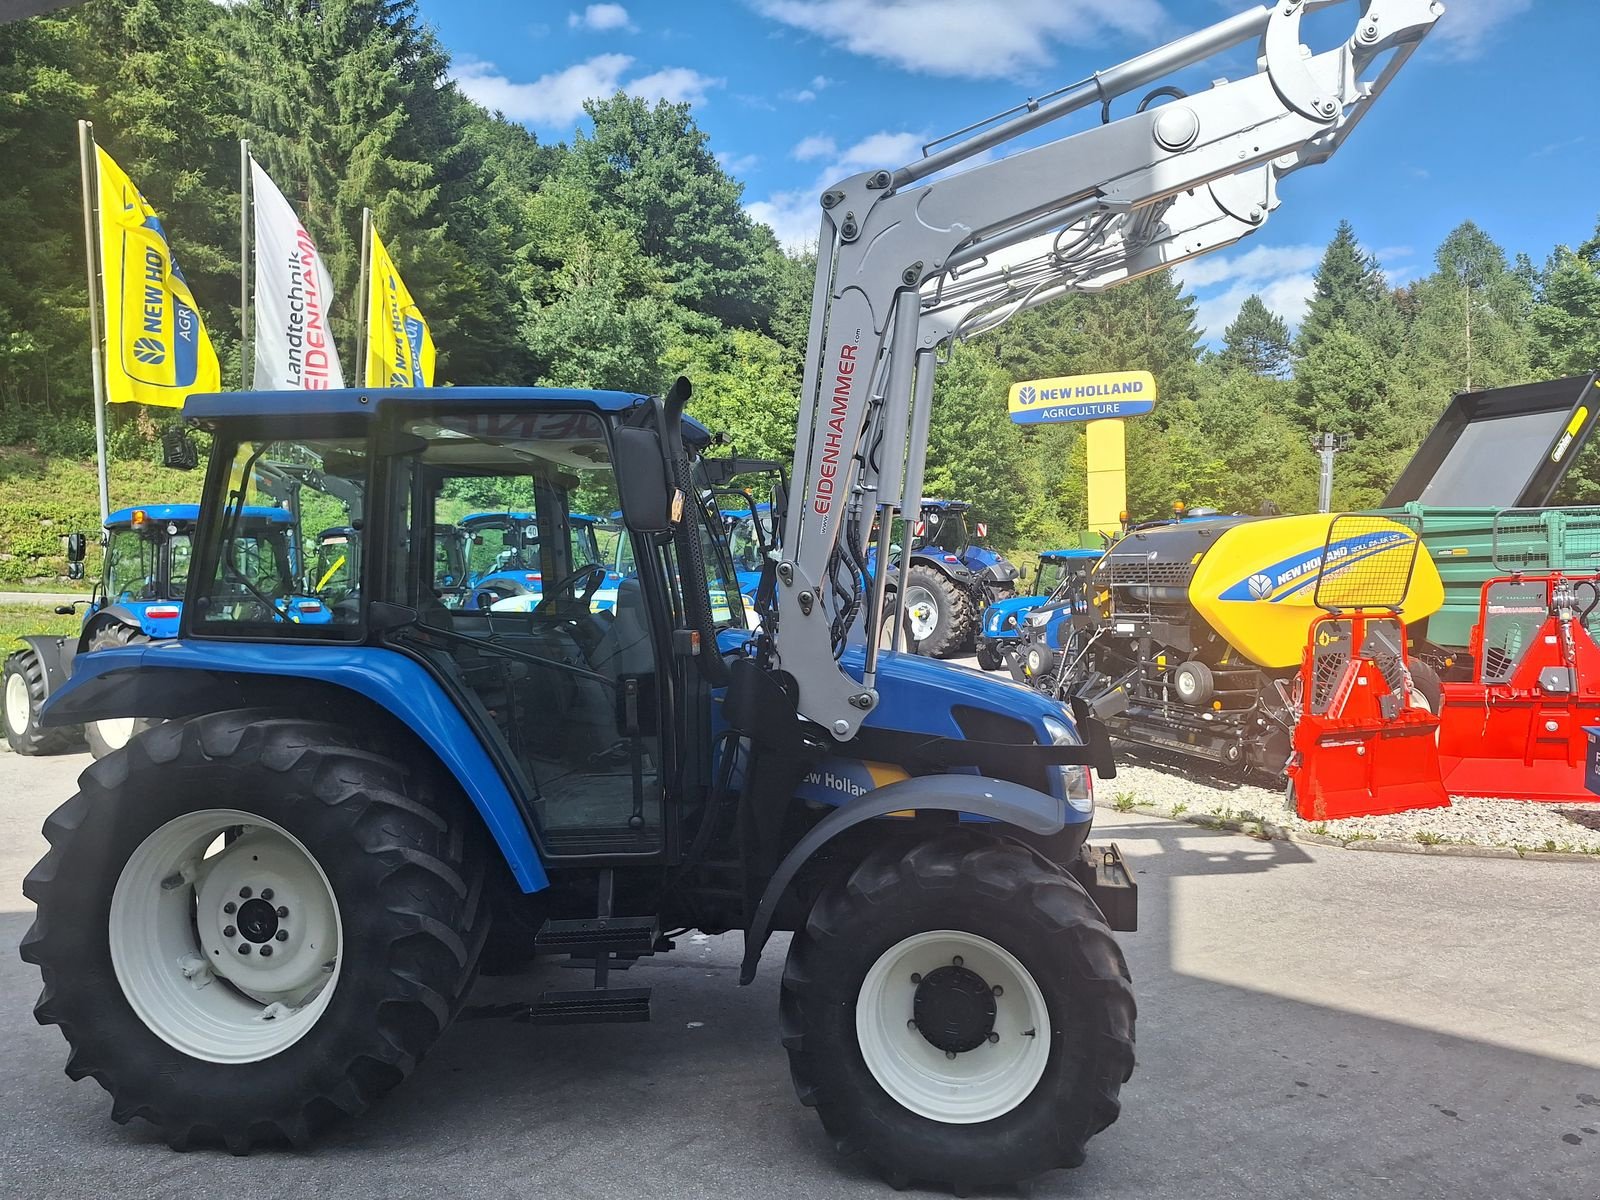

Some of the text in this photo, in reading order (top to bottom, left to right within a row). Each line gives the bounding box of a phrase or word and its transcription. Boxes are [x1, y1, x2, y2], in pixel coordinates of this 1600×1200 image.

[144, 286, 163, 333] NEW
[286, 251, 303, 387] Landtechnik
[1040, 381, 1143, 400] NEW HOLLAND
[1042, 404, 1120, 419] AGRICULTURE
[814, 344, 858, 515] EIDENHAMMER
[527, 526, 537, 536] 40
[1277, 565, 1302, 586] NEW
